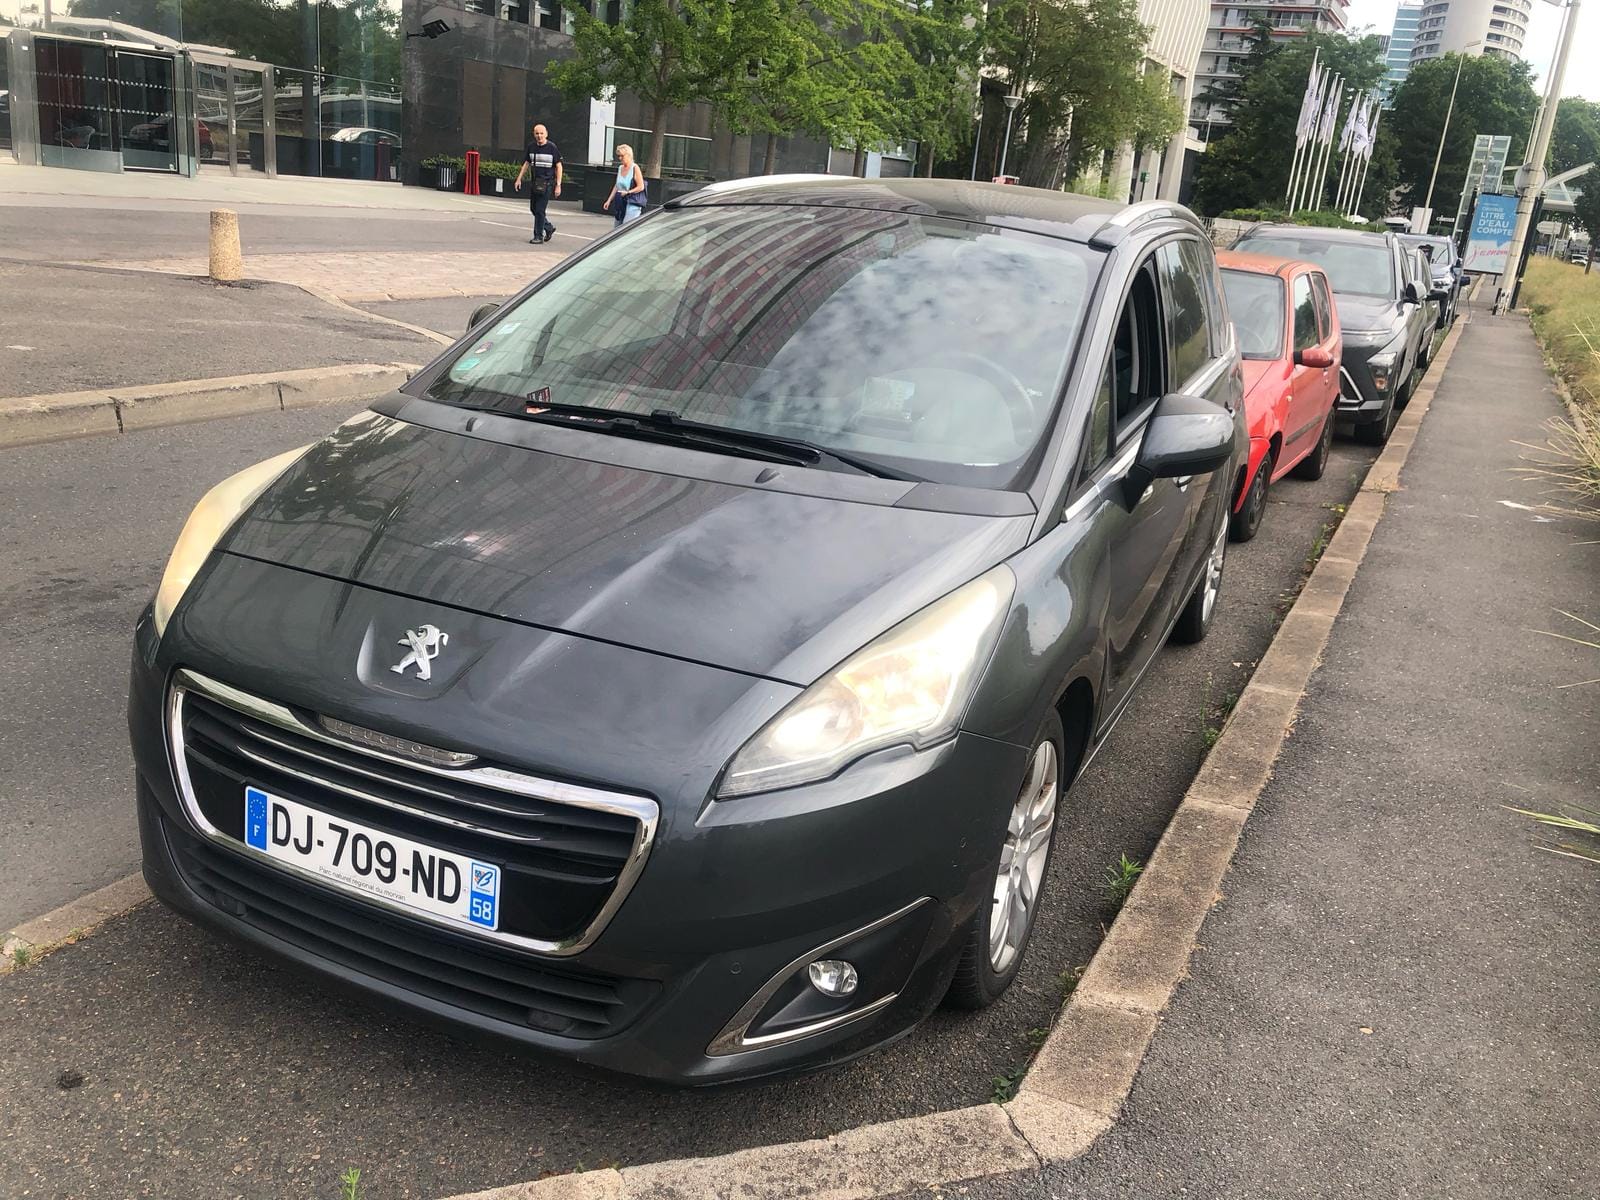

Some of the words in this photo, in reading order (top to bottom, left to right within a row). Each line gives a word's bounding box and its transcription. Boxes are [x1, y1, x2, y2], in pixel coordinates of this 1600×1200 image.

[1480, 212, 1505, 220] LITRE
[1478, 219, 1510, 228] D'EAU
[1476, 227, 1513, 236] COMPTE
[253, 824, 260, 837] F
[272, 802, 462, 905] DJ-709-ND
[319, 865, 331, 876] Parc
[332, 870, 352, 883] naturel
[375, 885, 383, 894] du
[384, 889, 406, 901] morvan
[472, 896, 492, 921] 58
